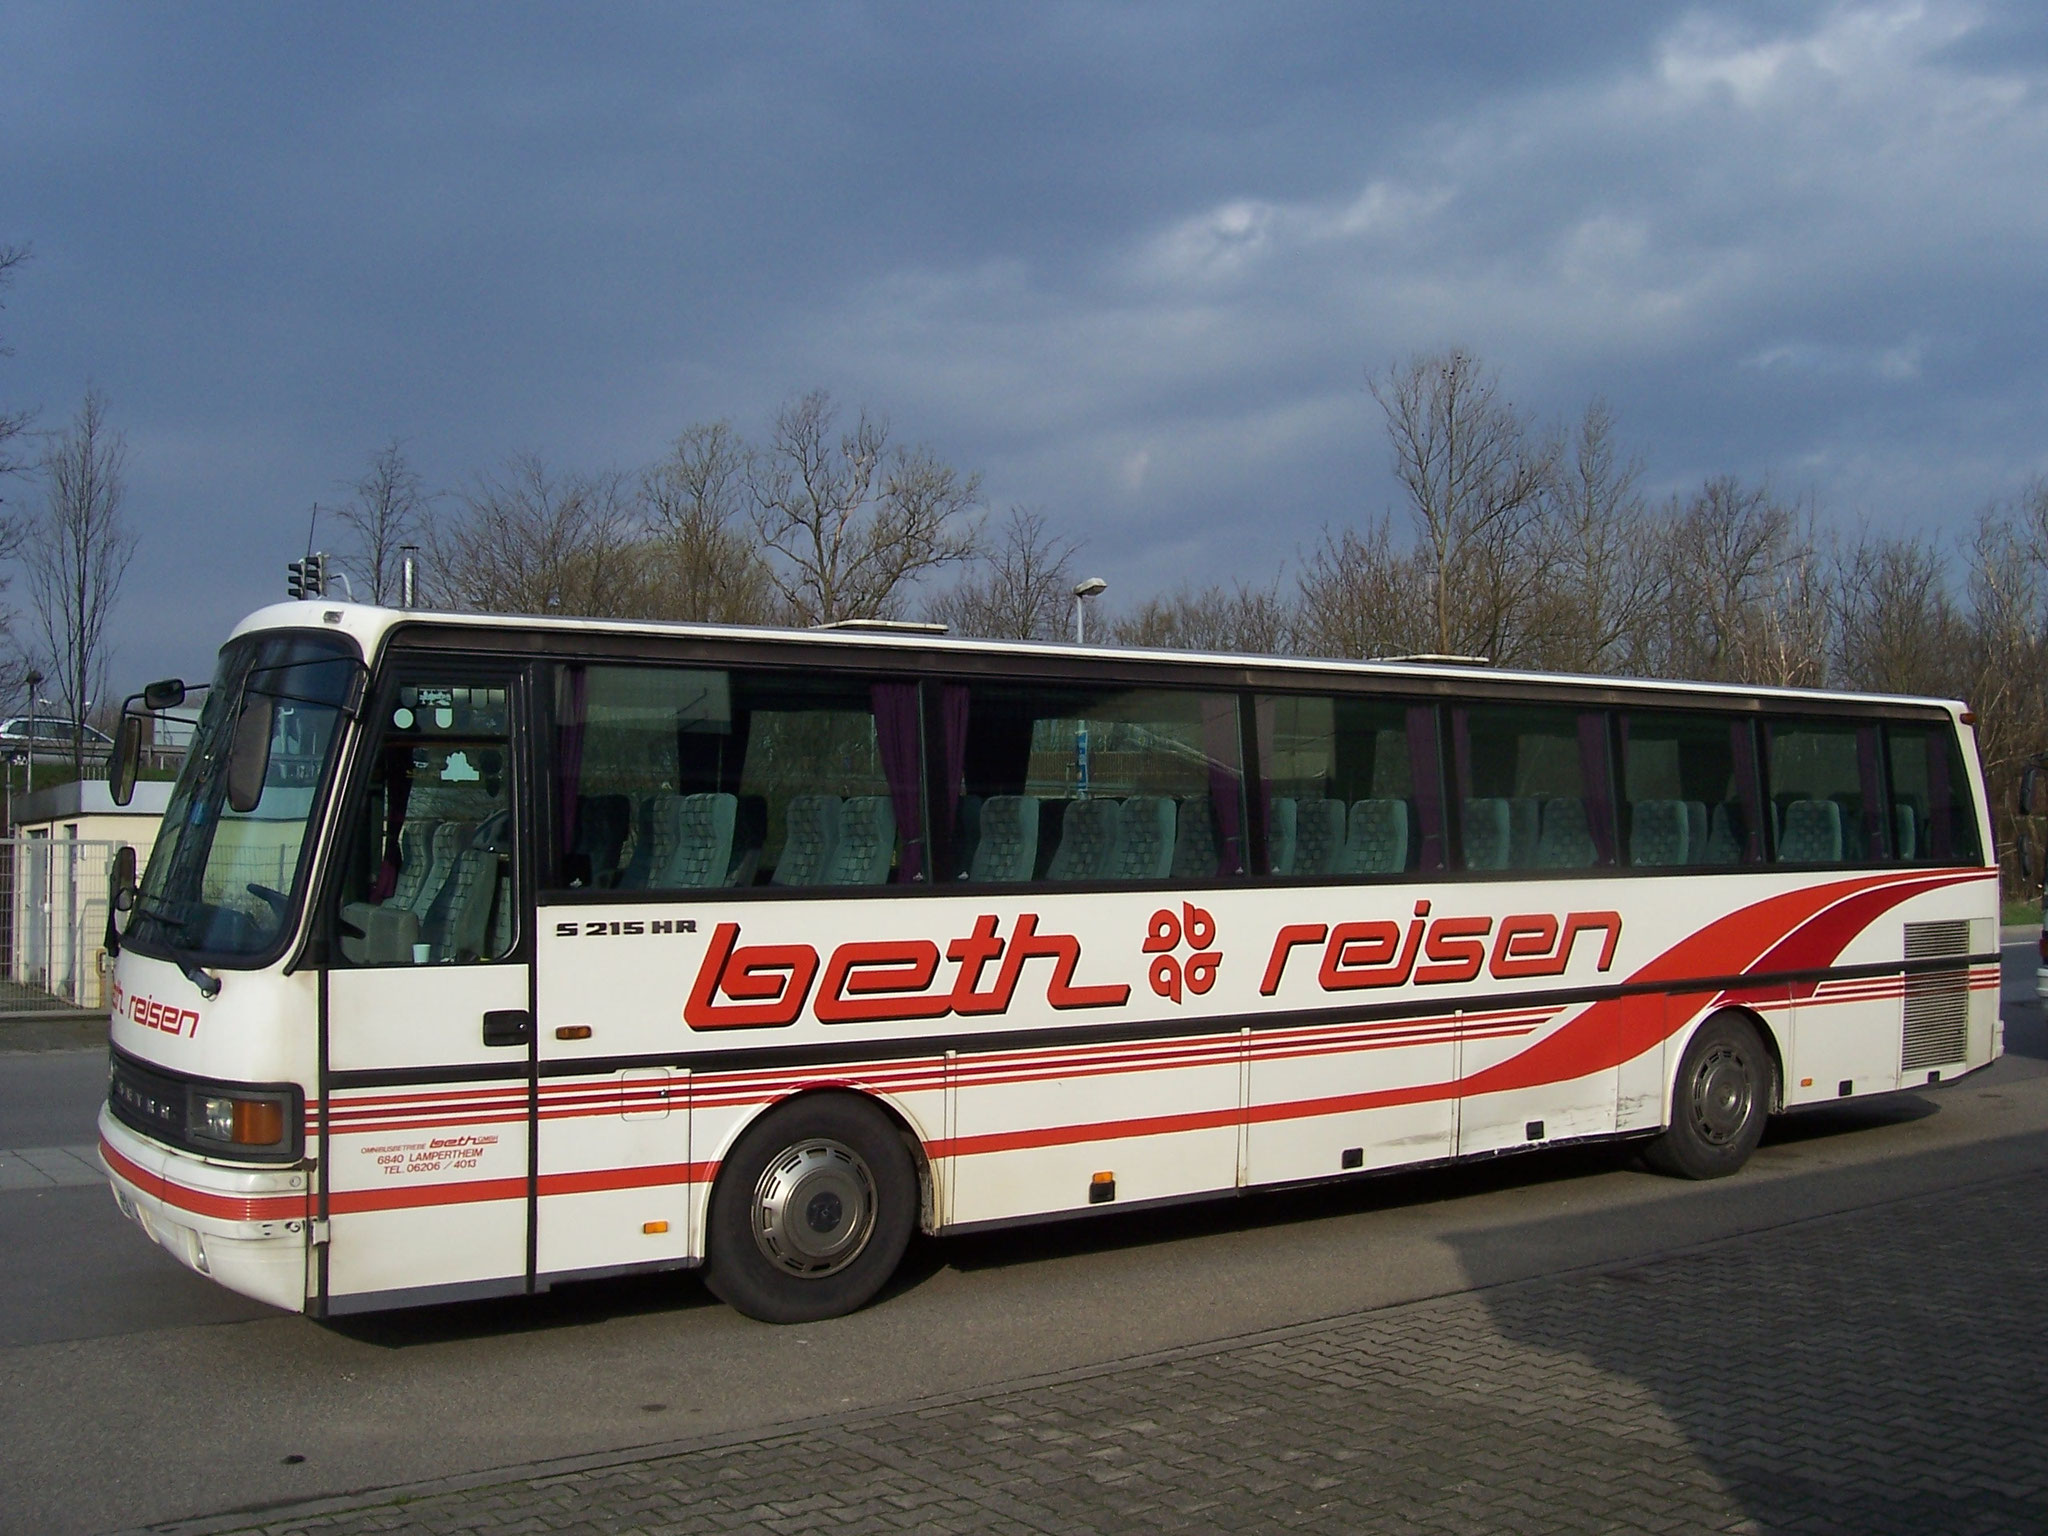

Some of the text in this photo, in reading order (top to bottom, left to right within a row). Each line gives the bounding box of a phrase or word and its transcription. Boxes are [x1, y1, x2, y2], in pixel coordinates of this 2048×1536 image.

[556, 920, 697, 936] S 215 HR
[684, 900, 1623, 1031] beth reisen
[128, 994, 200, 1038] reisen
[430, 1136, 498, 1148] beth
[377, 1148, 483, 1165] 6840 LAMPERTHEIM
